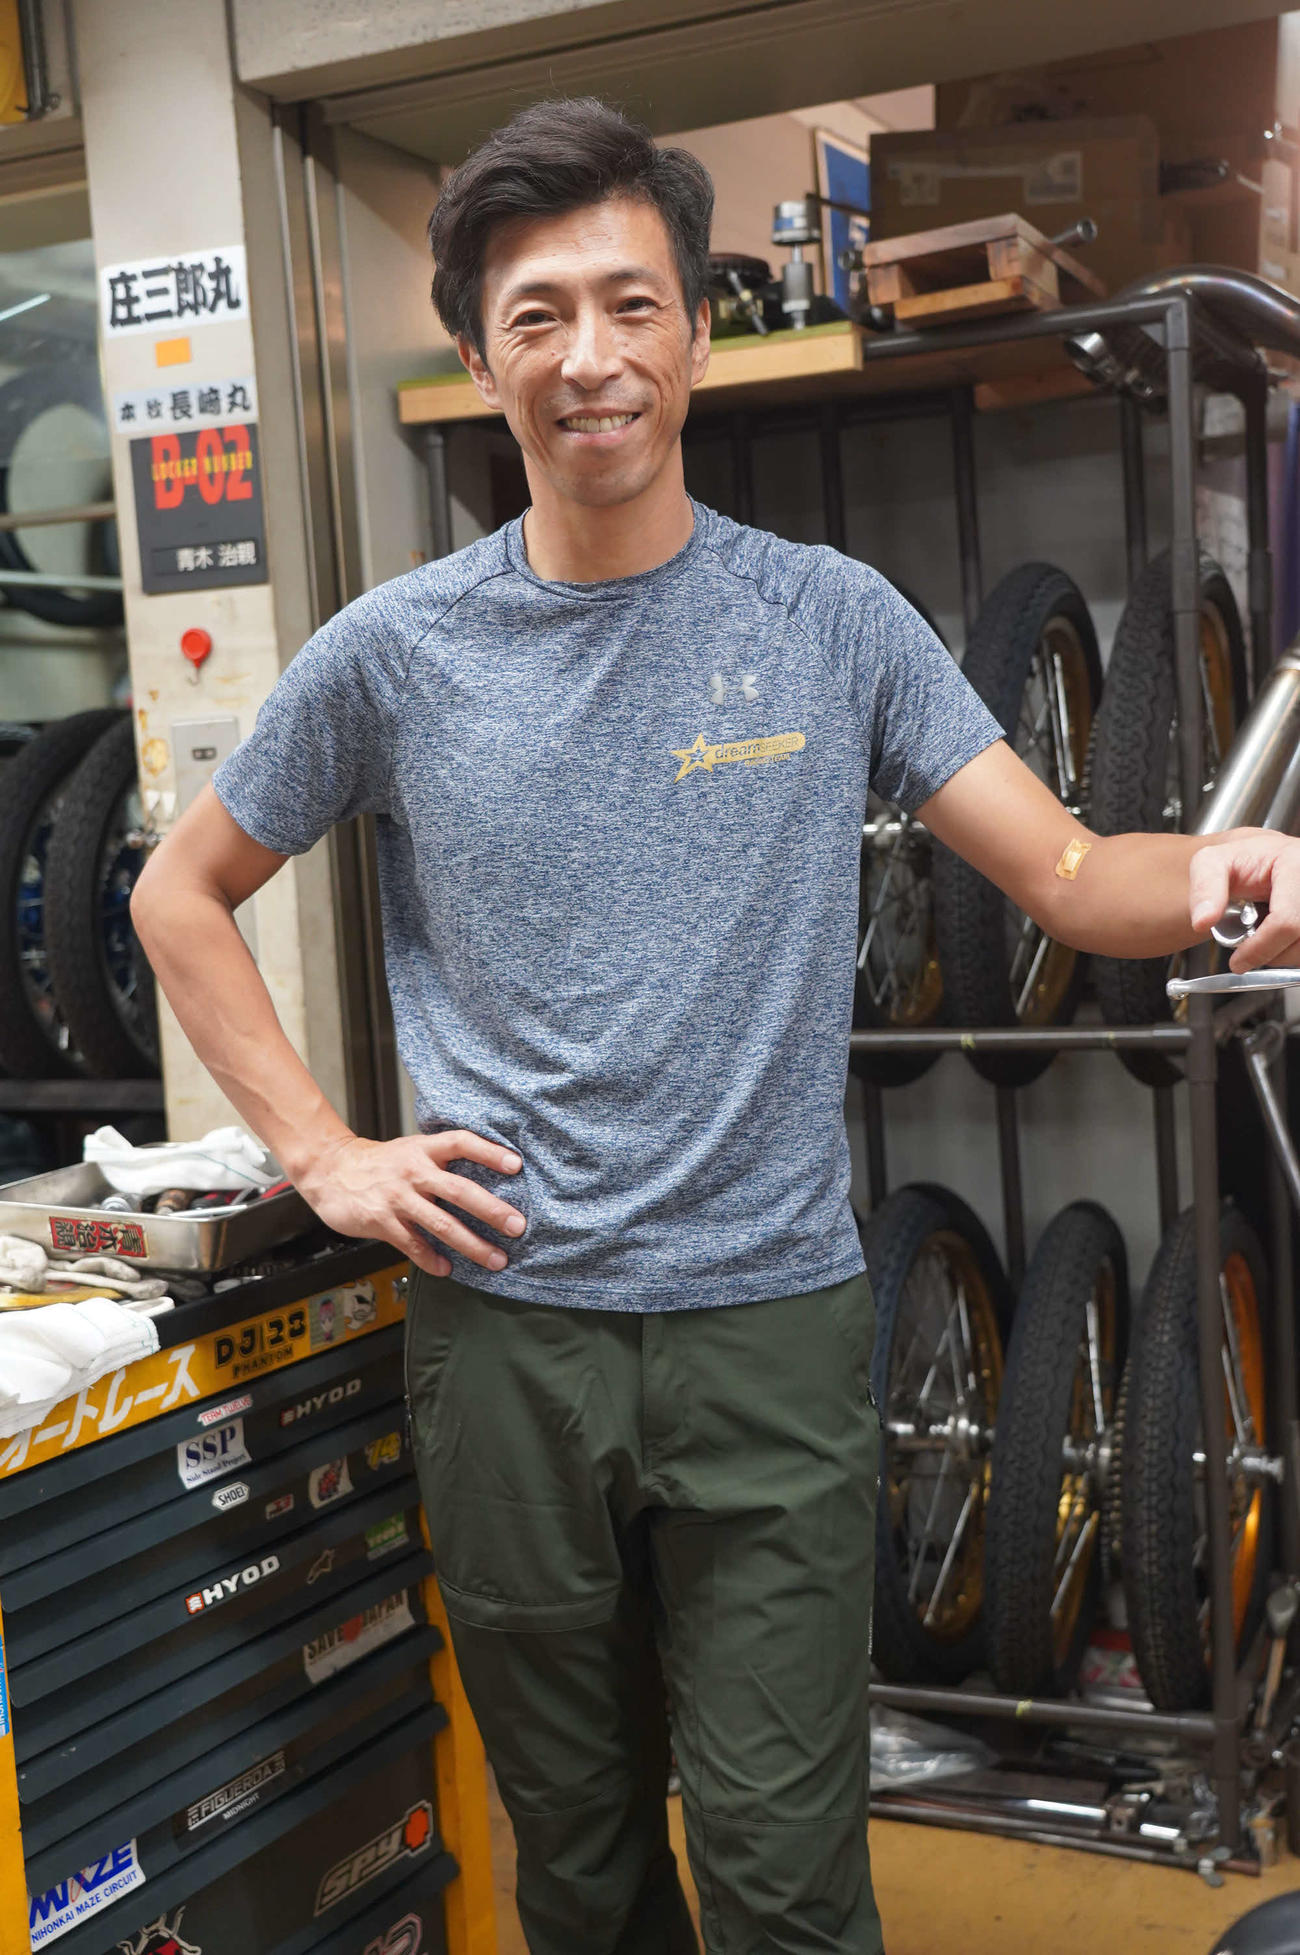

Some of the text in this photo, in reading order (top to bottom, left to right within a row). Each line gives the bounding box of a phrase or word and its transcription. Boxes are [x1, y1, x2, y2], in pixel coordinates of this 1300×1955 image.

[108, 256, 241, 328] 庄三郎丸
[151, 424, 253, 510] B-02
[294, 1378, 362, 1419] HYOD
[186, 1425, 236, 1469] SSP
[218, 1486, 245, 1506] SHOEI
[202, 1555, 280, 1605] HYOD
[31, 1869, 138, 1943] NIHONKAI MAZE CIRCUIT
